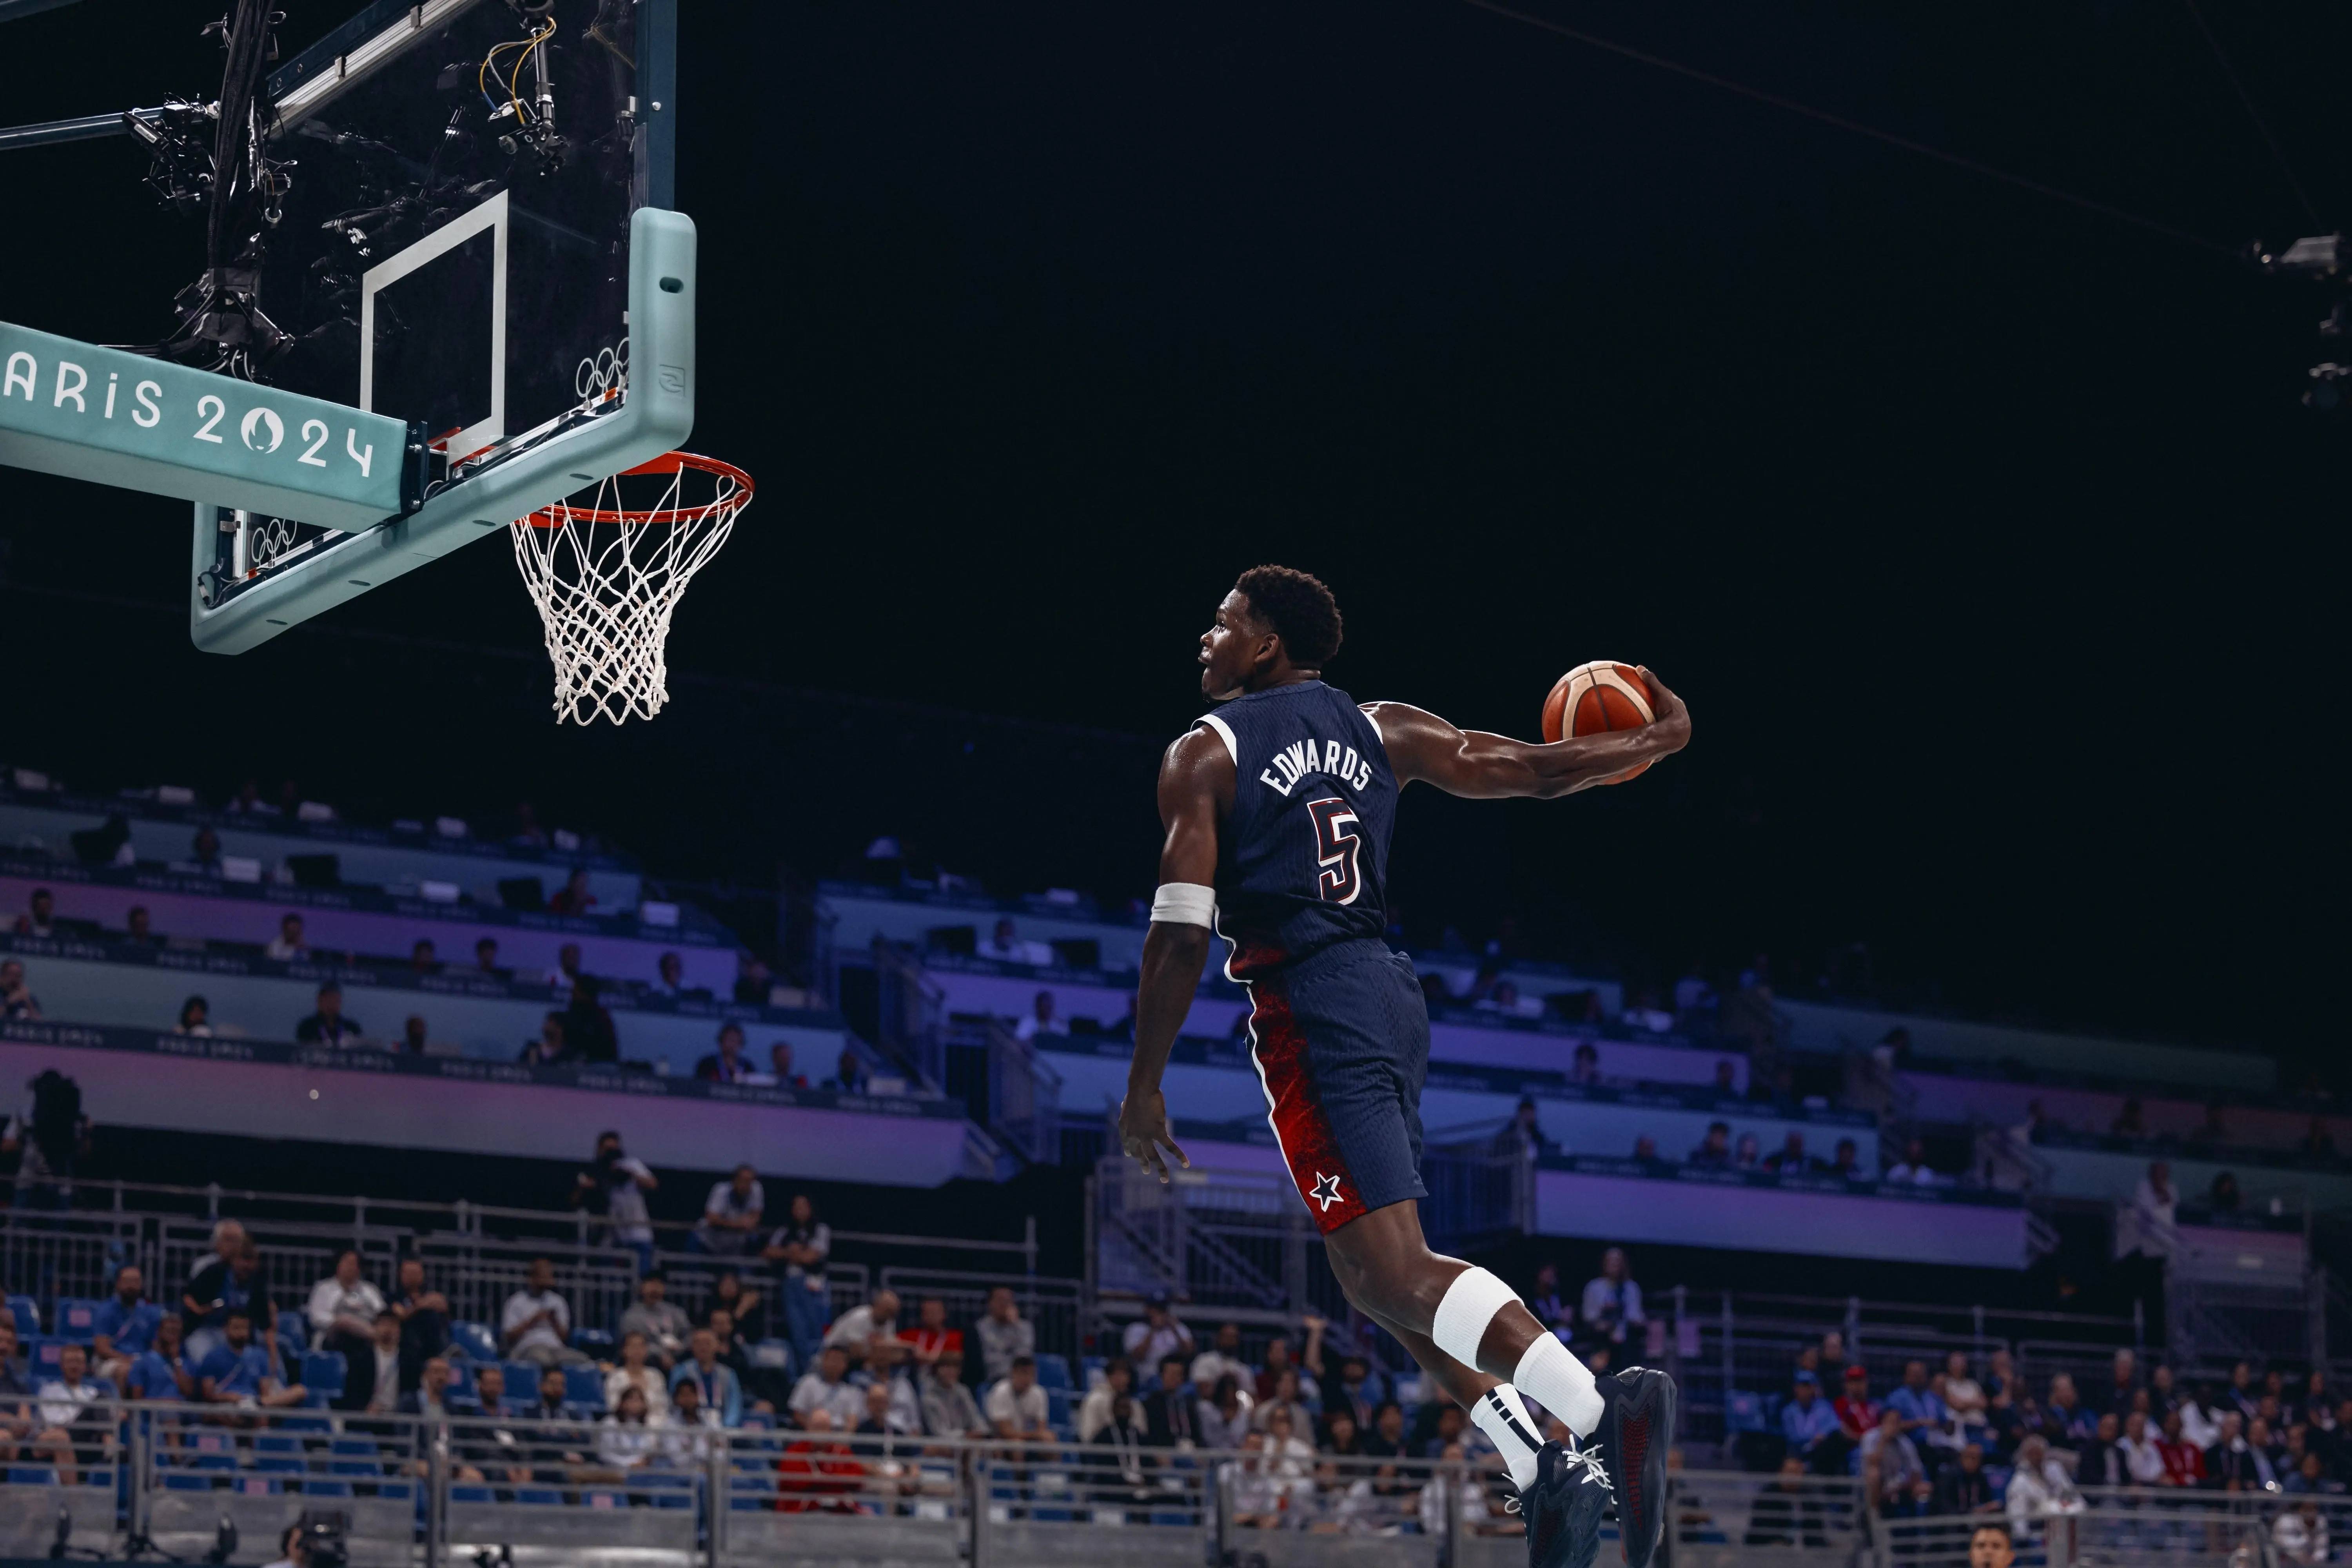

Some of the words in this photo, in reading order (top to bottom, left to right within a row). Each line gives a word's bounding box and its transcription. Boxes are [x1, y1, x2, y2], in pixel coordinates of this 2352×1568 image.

[193, 395, 373, 477] 2024
[1259, 739, 1372, 797] EDWARDS
[1307, 797, 1361, 906] 5
